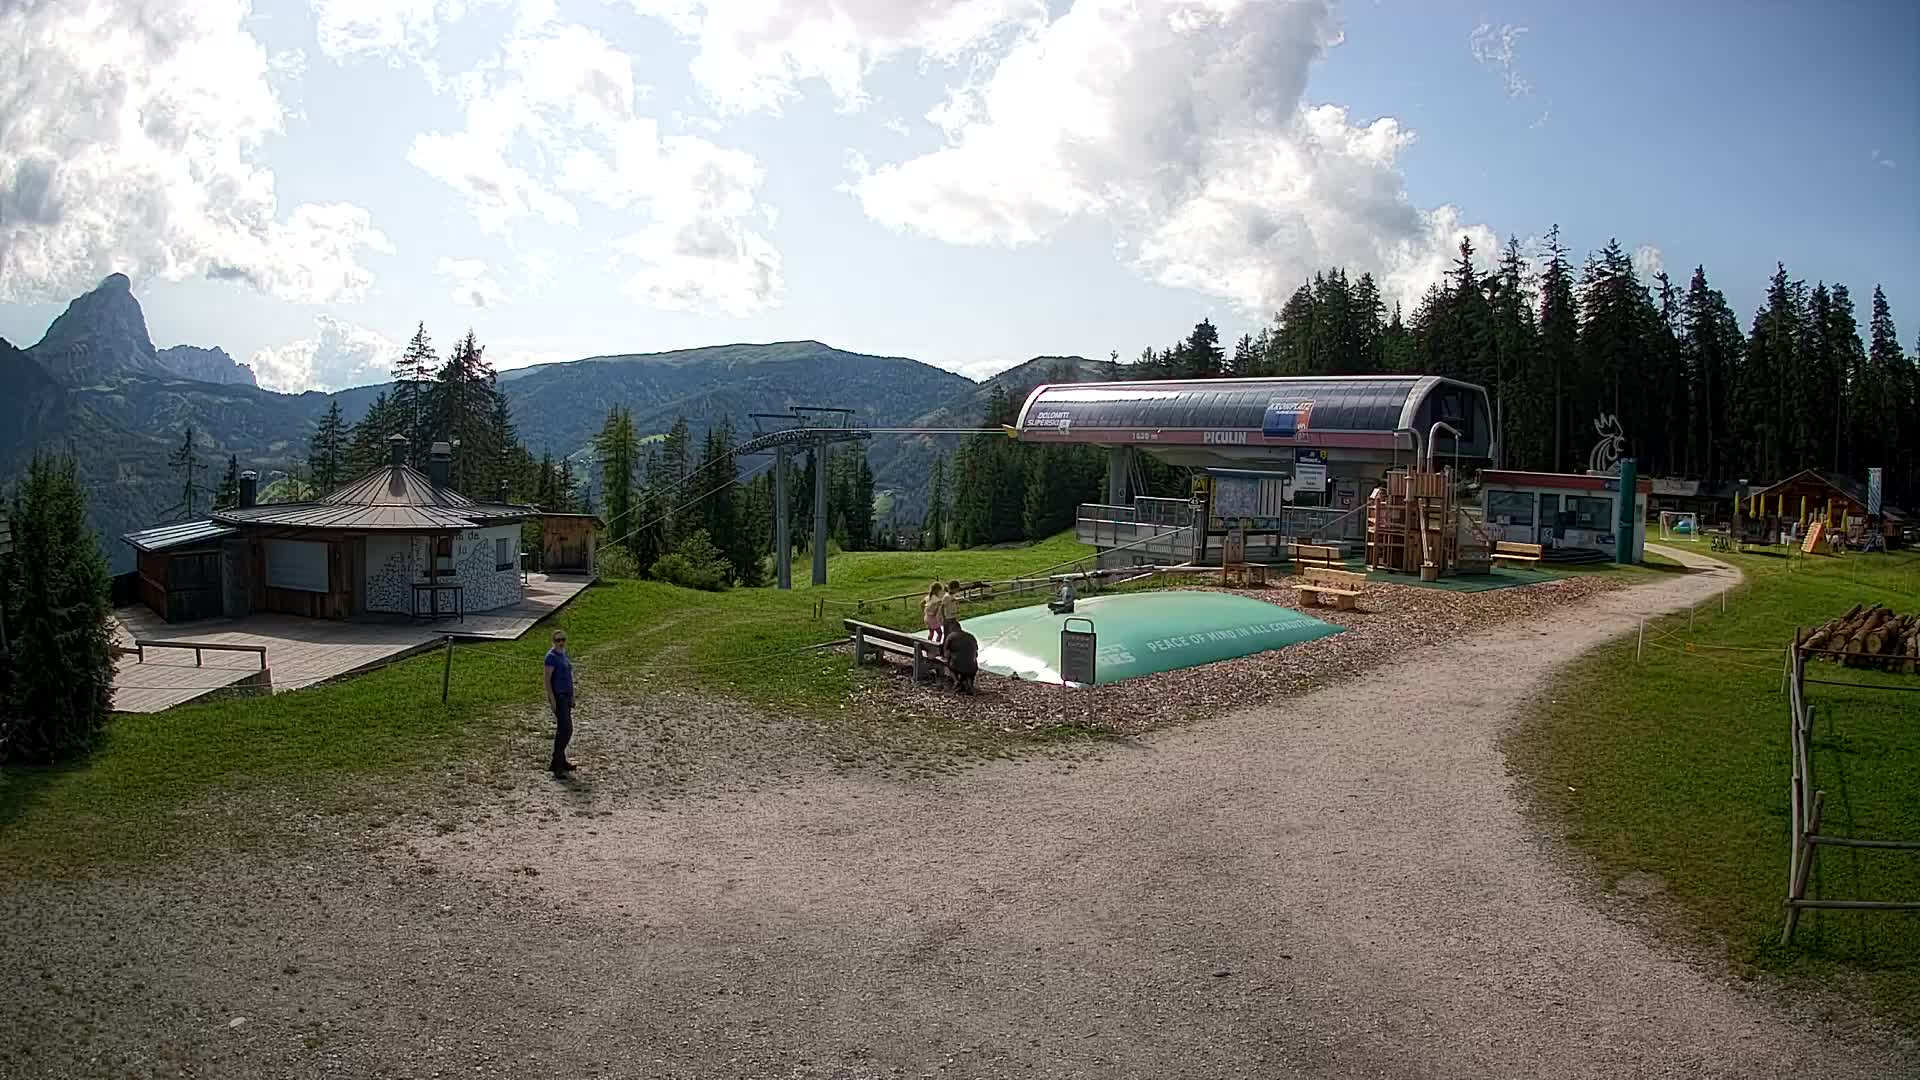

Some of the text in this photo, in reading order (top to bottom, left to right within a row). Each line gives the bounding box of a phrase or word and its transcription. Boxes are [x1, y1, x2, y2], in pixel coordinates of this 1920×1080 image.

[1037, 411, 1070, 419] DOLOMITI
[1203, 431, 1247, 444] PICULIN
[1147, 636, 1190, 652] PEACE
[1189, 633, 1205, 644] OF
[1206, 630, 1236, 641] MIND
[1235, 627, 1250, 637] IN
[1249, 624, 1272, 635] ALL
